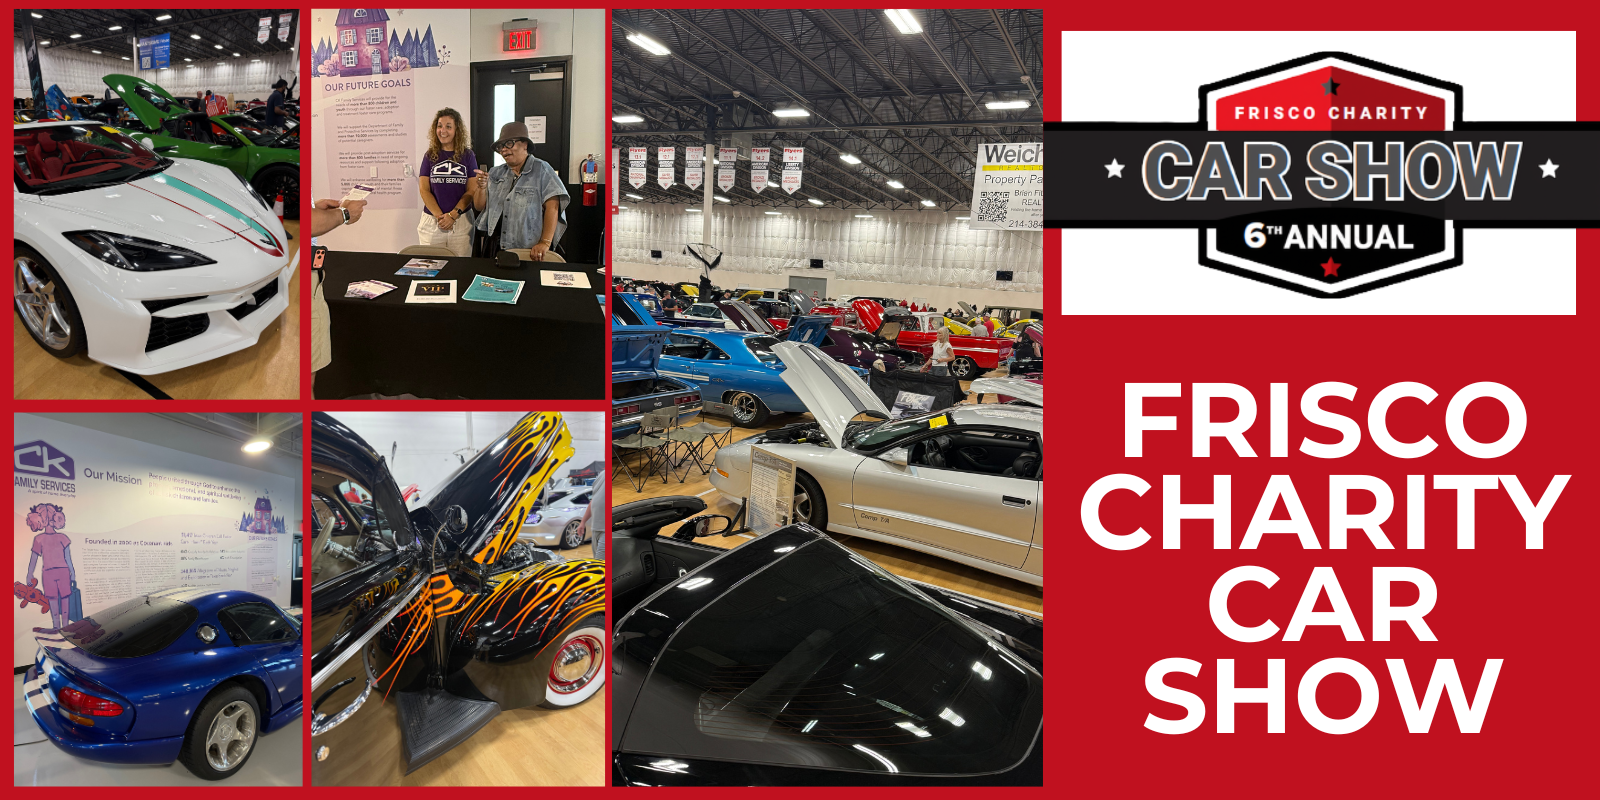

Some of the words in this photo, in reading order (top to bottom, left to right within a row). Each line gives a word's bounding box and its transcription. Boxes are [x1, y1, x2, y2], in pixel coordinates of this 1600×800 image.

[509, 31, 532, 50] EXIT
[325, 83, 344, 91] OUR
[346, 81, 379, 91] FUTURE
[381, 79, 411, 88] GOALS
[984, 174, 1026, 186] Property
[84, 467, 104, 480] Our
[106, 471, 142, 485] Mission
[40, 480, 76, 492] SERVICES
[861, 513, 878, 521] Comp
